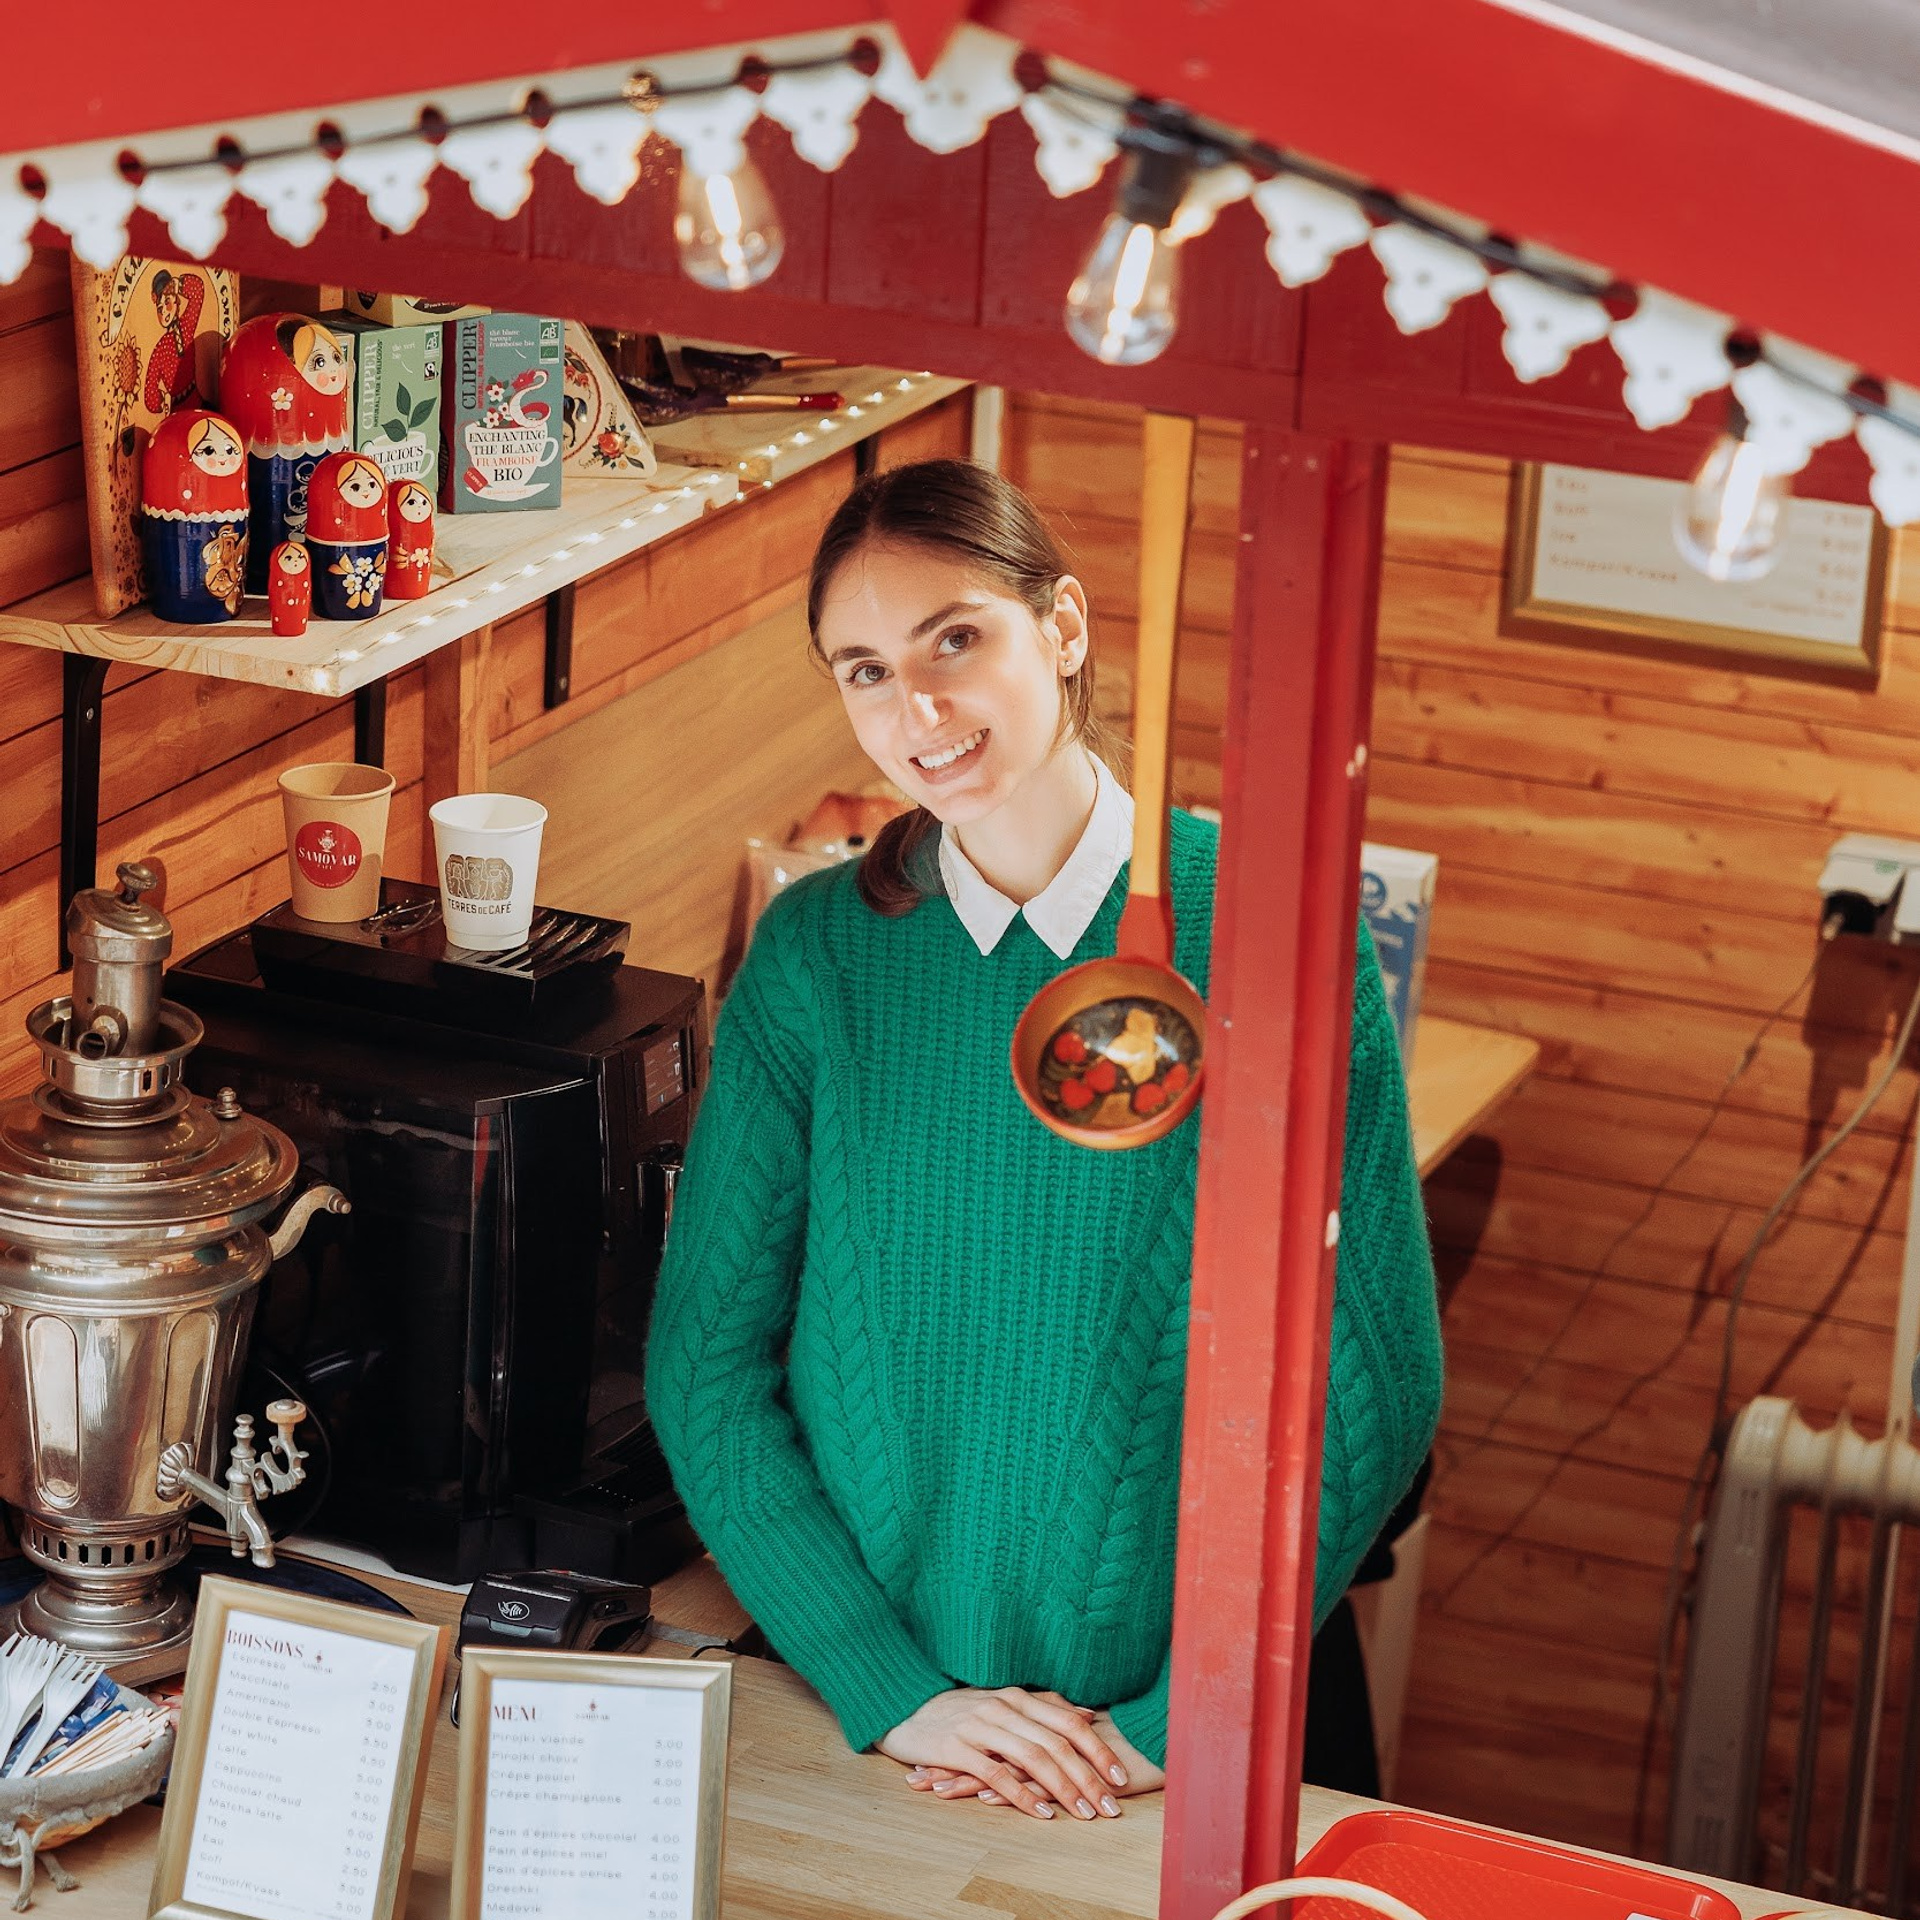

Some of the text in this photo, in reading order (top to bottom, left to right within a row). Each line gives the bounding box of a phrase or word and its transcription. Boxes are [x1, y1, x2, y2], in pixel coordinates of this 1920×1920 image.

[461, 323, 477, 410] CLIPPER
[362, 341, 378, 430] CLIPPER
[469, 430, 545, 443] ENCHANTING
[502, 443, 542, 454] BLANC
[392, 461, 421, 475] VERT
[494, 467, 523, 482] BIO
[298, 846, 357, 867] SAMOVAR
[447, 898, 512, 915] TERRES DE CAFÉ
[227, 1629, 304, 1658] BOISSONS
[494, 1705, 542, 1722] MENU
